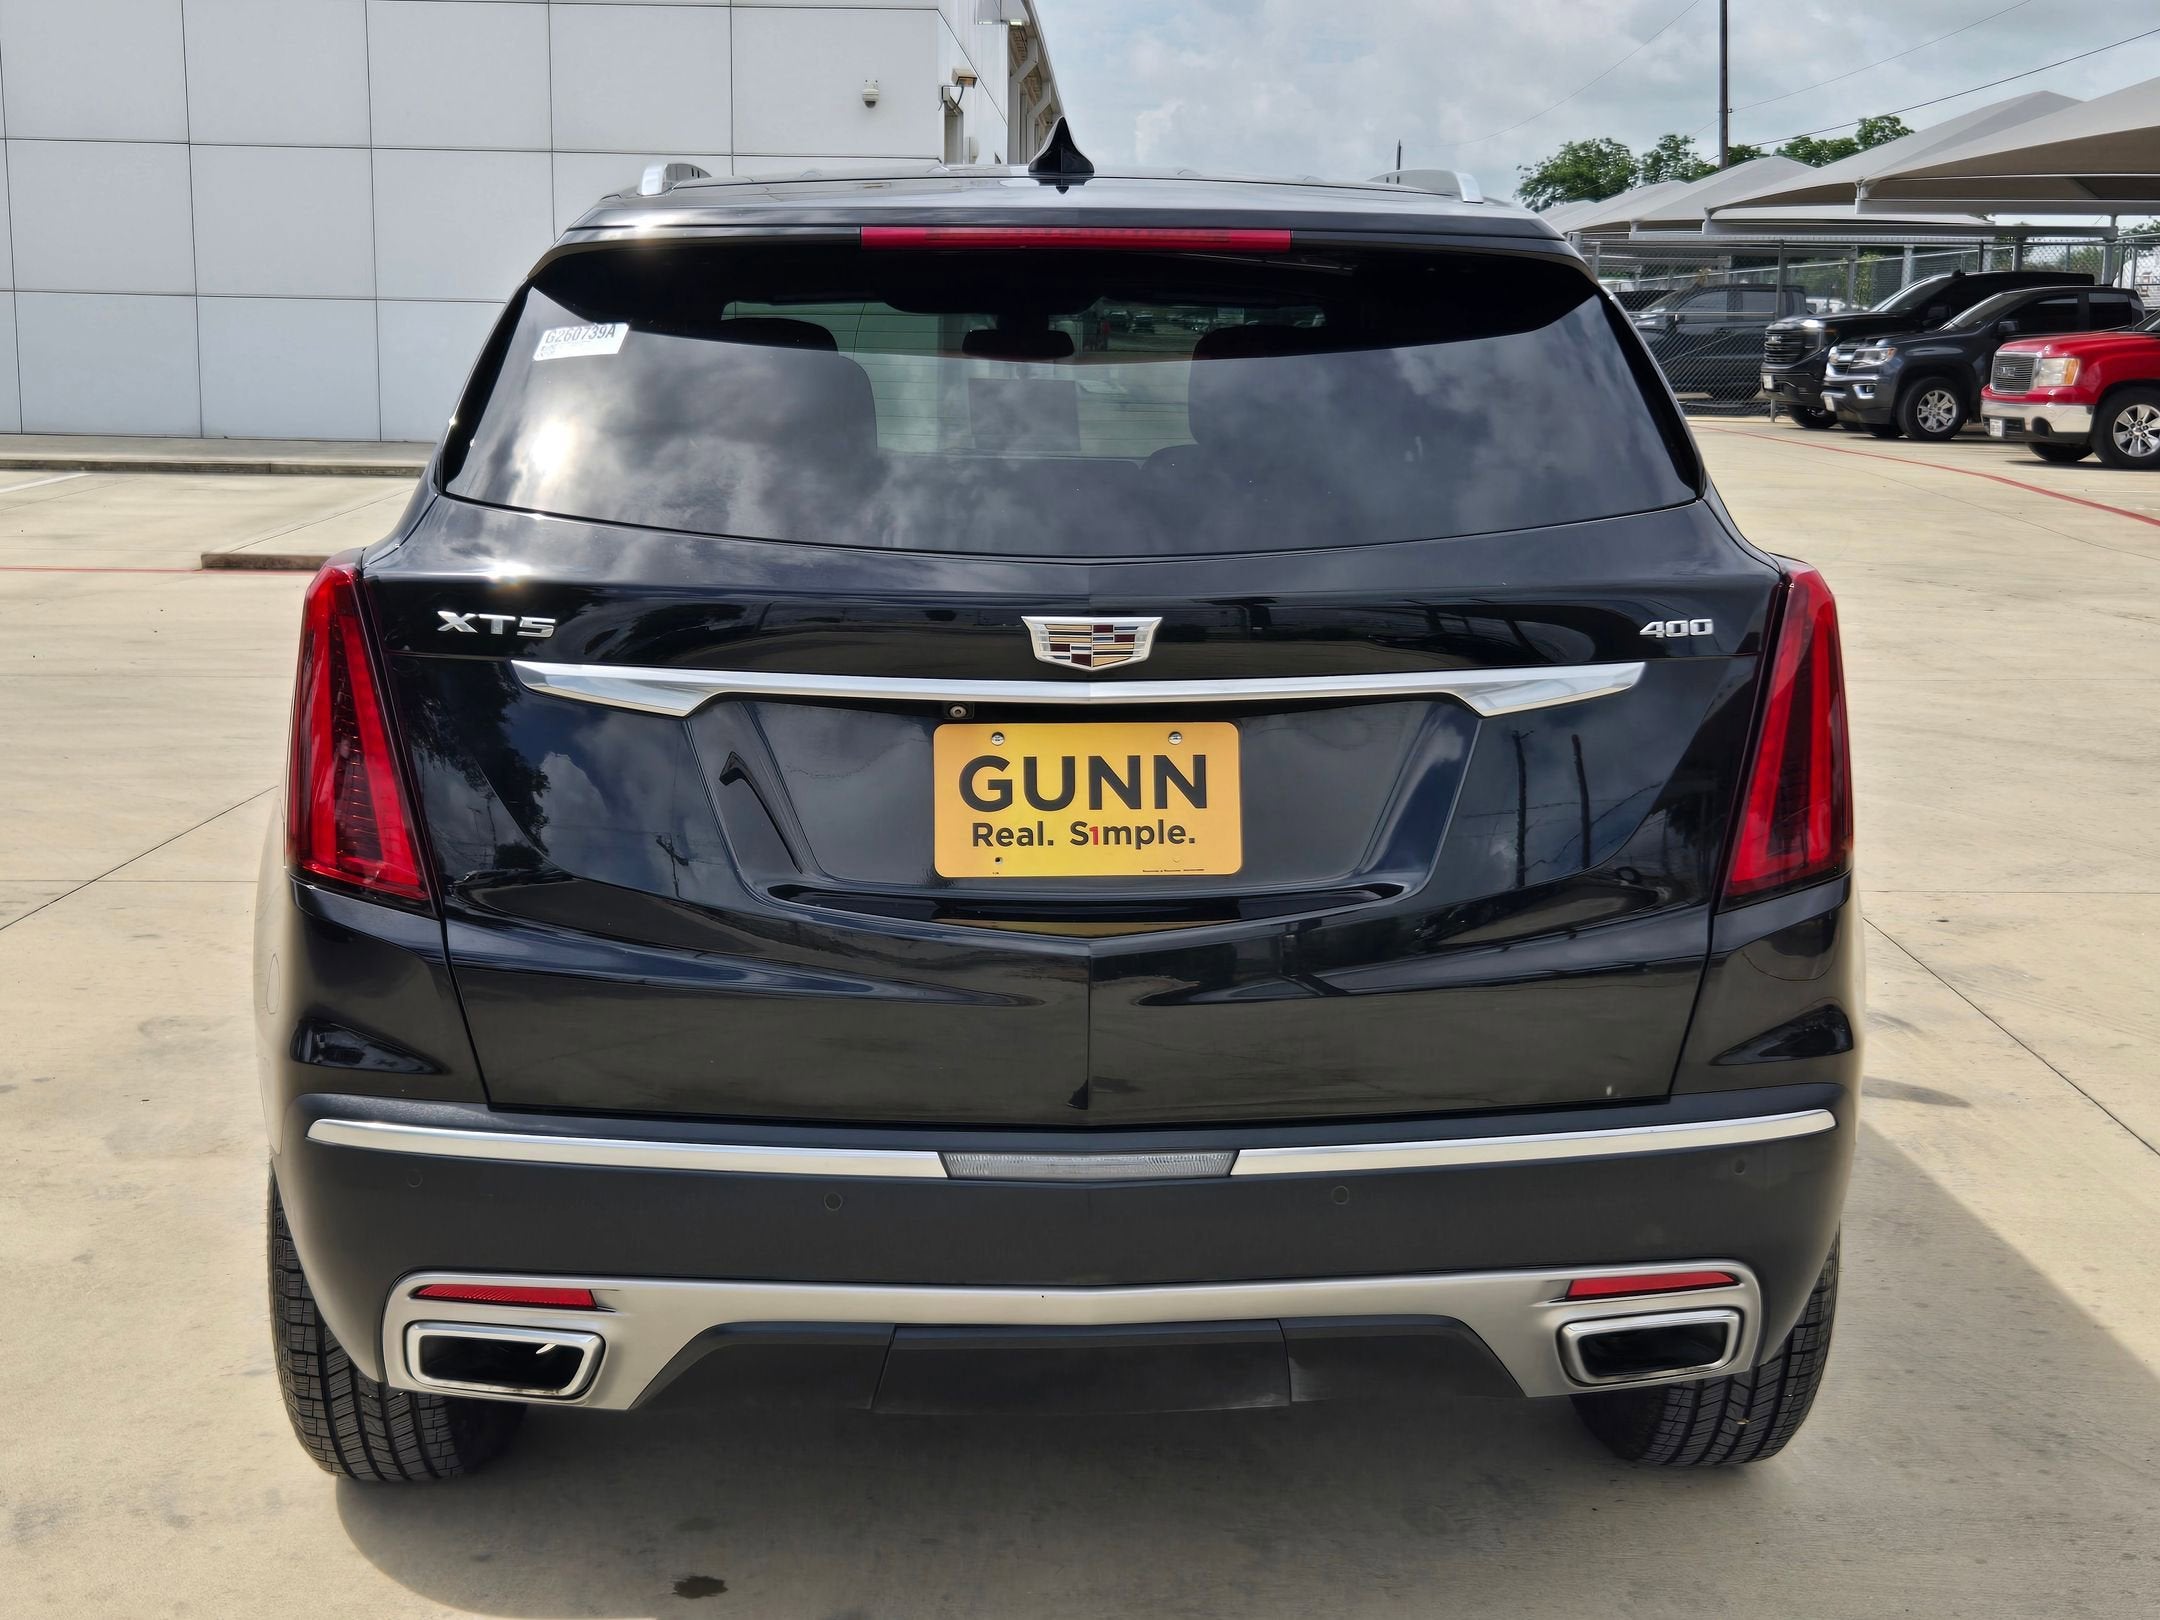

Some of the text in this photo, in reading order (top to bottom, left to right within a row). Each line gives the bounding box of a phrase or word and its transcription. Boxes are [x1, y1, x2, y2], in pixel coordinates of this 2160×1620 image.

[545, 324, 616, 344] G260739A
[437, 610, 556, 638] XT5
[1639, 618, 1714, 638] 400
[958, 754, 1208, 813] GUNN
[972, 818, 1196, 850] Real. S1mple.
